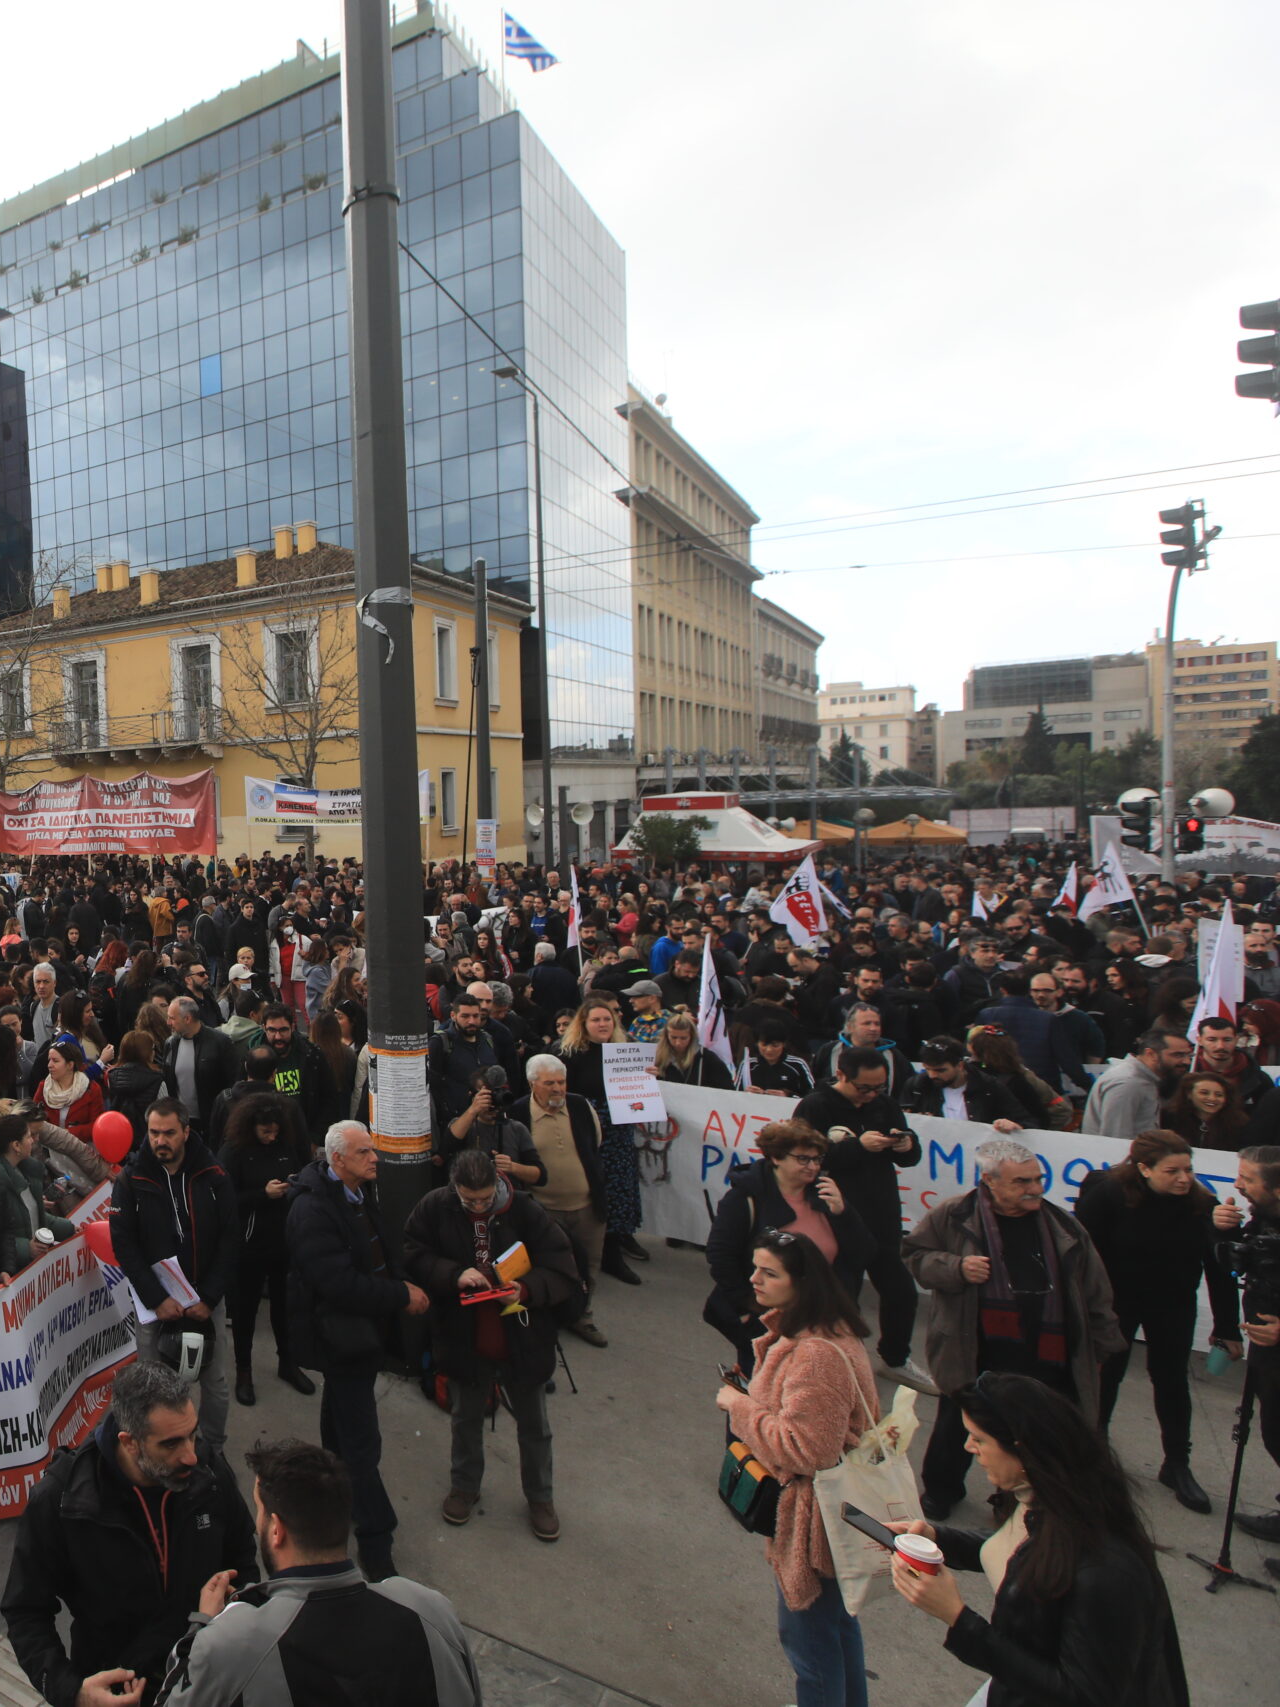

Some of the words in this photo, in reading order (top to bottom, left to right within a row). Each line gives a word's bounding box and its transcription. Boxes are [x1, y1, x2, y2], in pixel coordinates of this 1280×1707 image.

[6, 817, 29, 828] ΟΧΙ
[95, 811, 192, 825] ΠΑΝΕΠΙΣΤΗΜΙΑ
[52, 832, 64, 840] ΜΕ
[87, 828, 127, 838] ΔΩΡΕΑΝ
[129, 828, 176, 838] ΣΠΟΥΔΕΣ
[38, 1255, 75, 1305] ΔΟΥΛΕΙΑ,
